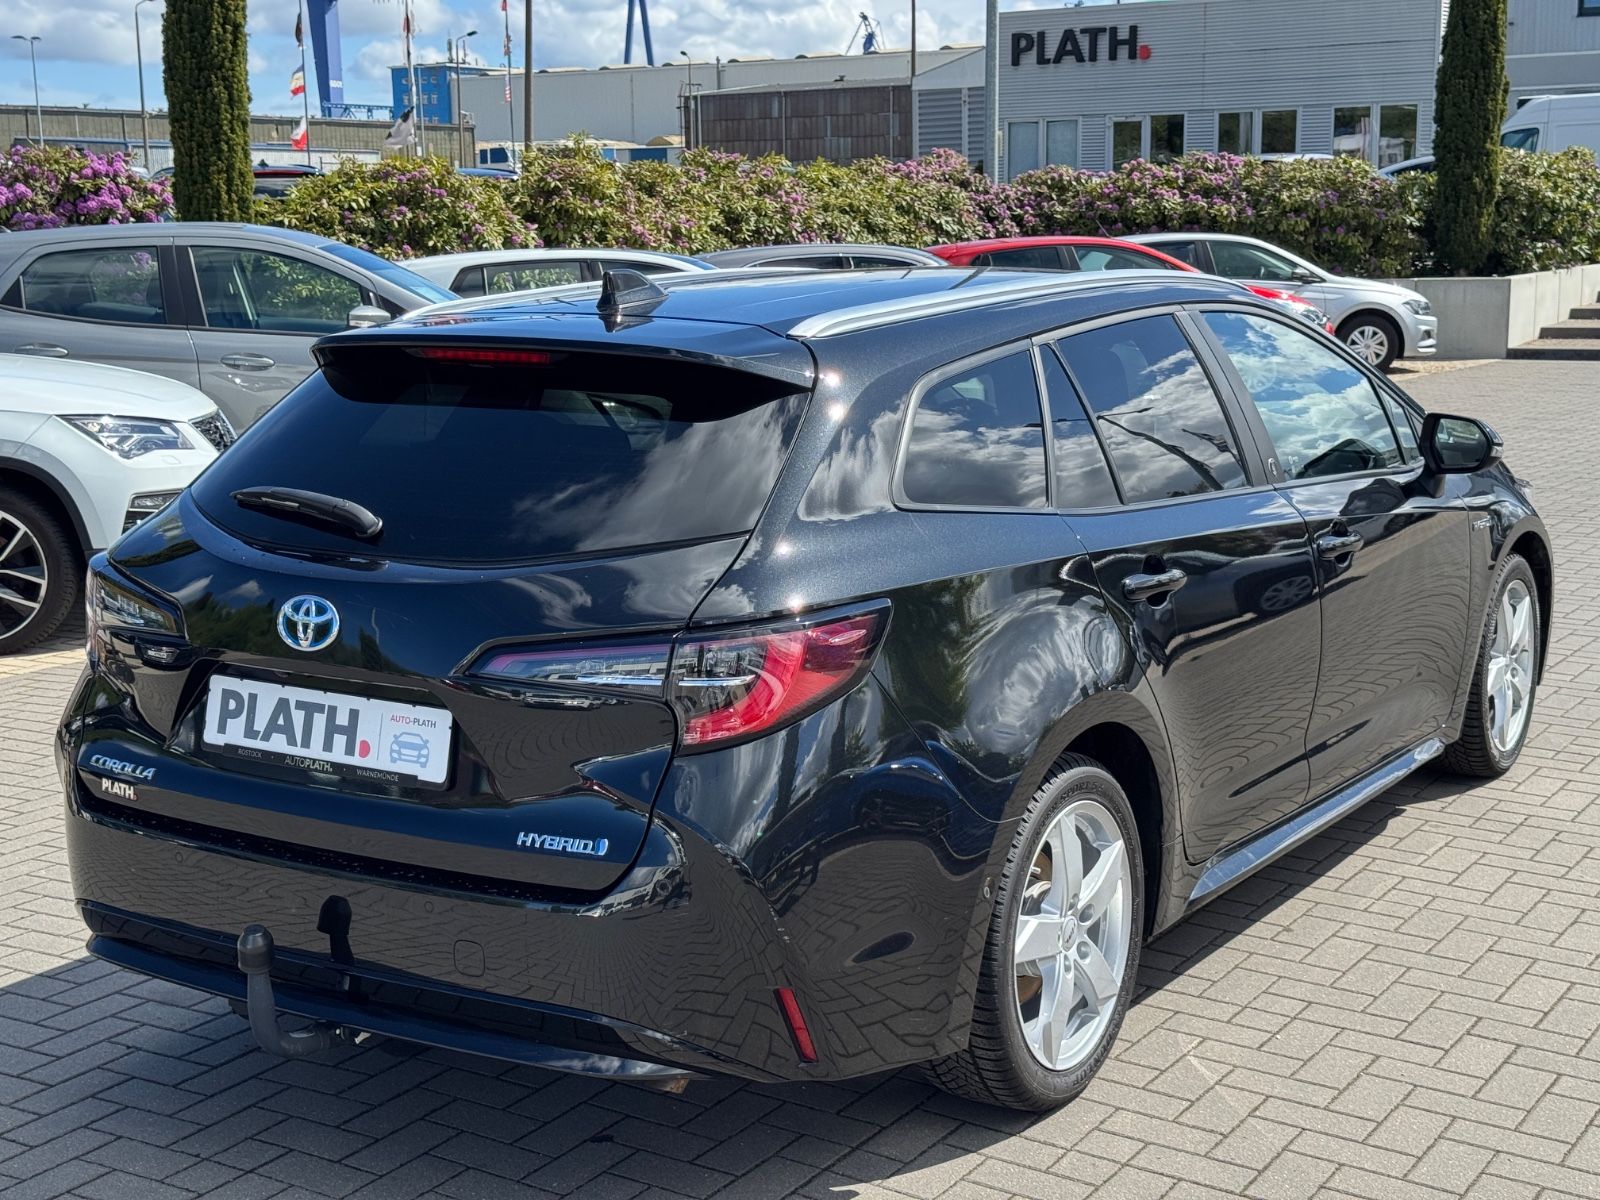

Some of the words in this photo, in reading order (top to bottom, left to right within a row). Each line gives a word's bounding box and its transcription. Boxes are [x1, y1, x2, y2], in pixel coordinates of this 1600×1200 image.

[390, 714, 437, 728] AUTO-PLATH
[89, 754, 157, 780] COROLLA
[238, 749, 262, 758] ROSTOCK
[356, 768, 399, 782] WARNEMÜNDE
